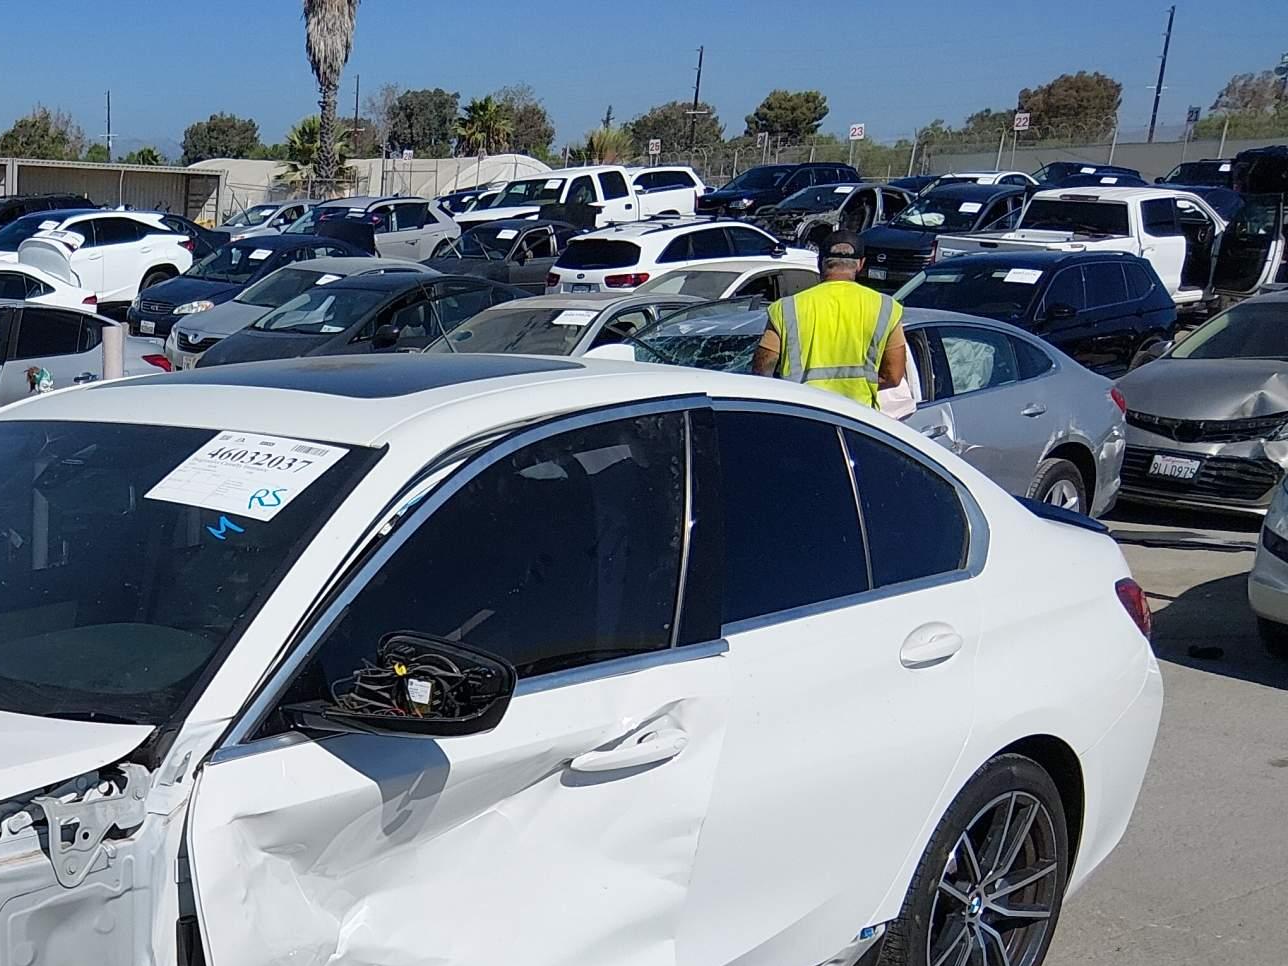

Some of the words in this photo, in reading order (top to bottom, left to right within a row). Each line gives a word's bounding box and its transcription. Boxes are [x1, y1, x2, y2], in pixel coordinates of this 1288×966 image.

[1015, 116, 1028, 127] 22
[851, 126, 863, 137] 23
[208, 446, 314, 473] 46032037
[248, 488, 288, 509] RS
